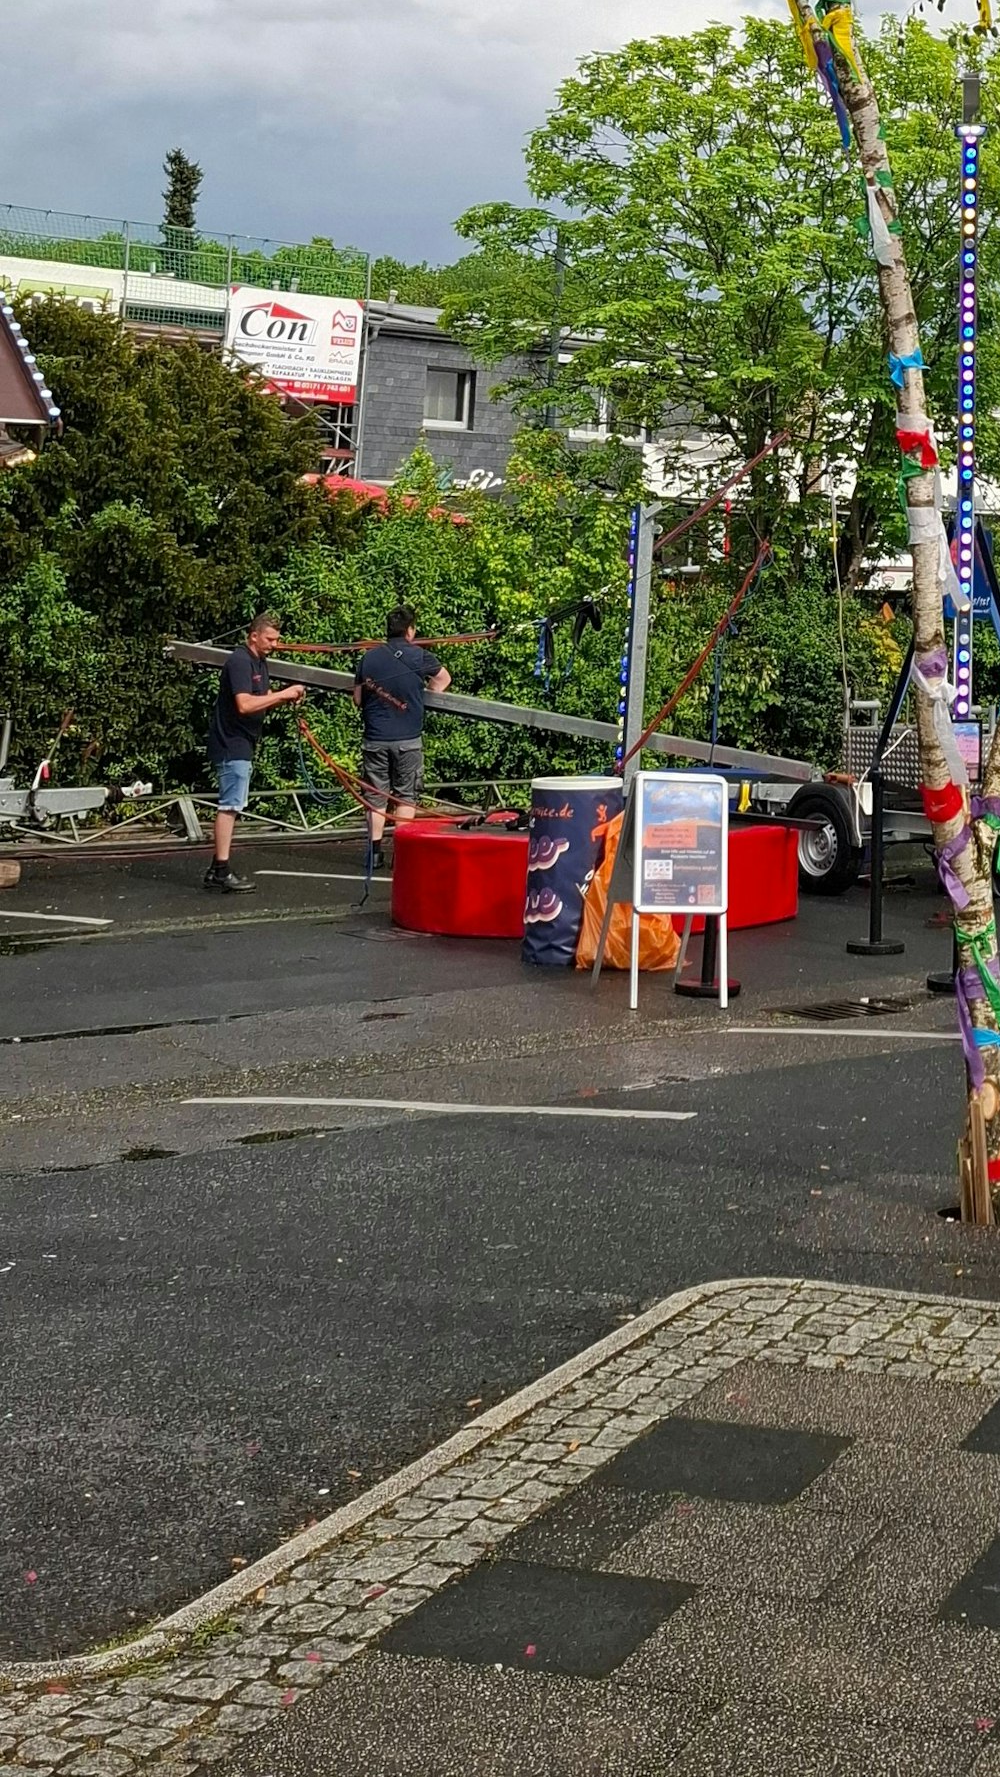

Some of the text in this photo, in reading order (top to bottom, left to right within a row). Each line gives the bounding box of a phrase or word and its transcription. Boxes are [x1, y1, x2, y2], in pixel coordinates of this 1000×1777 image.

[240, 308, 308, 341] Con
[271, 370, 352, 382] REPARATUR PV-ANLAGEN
